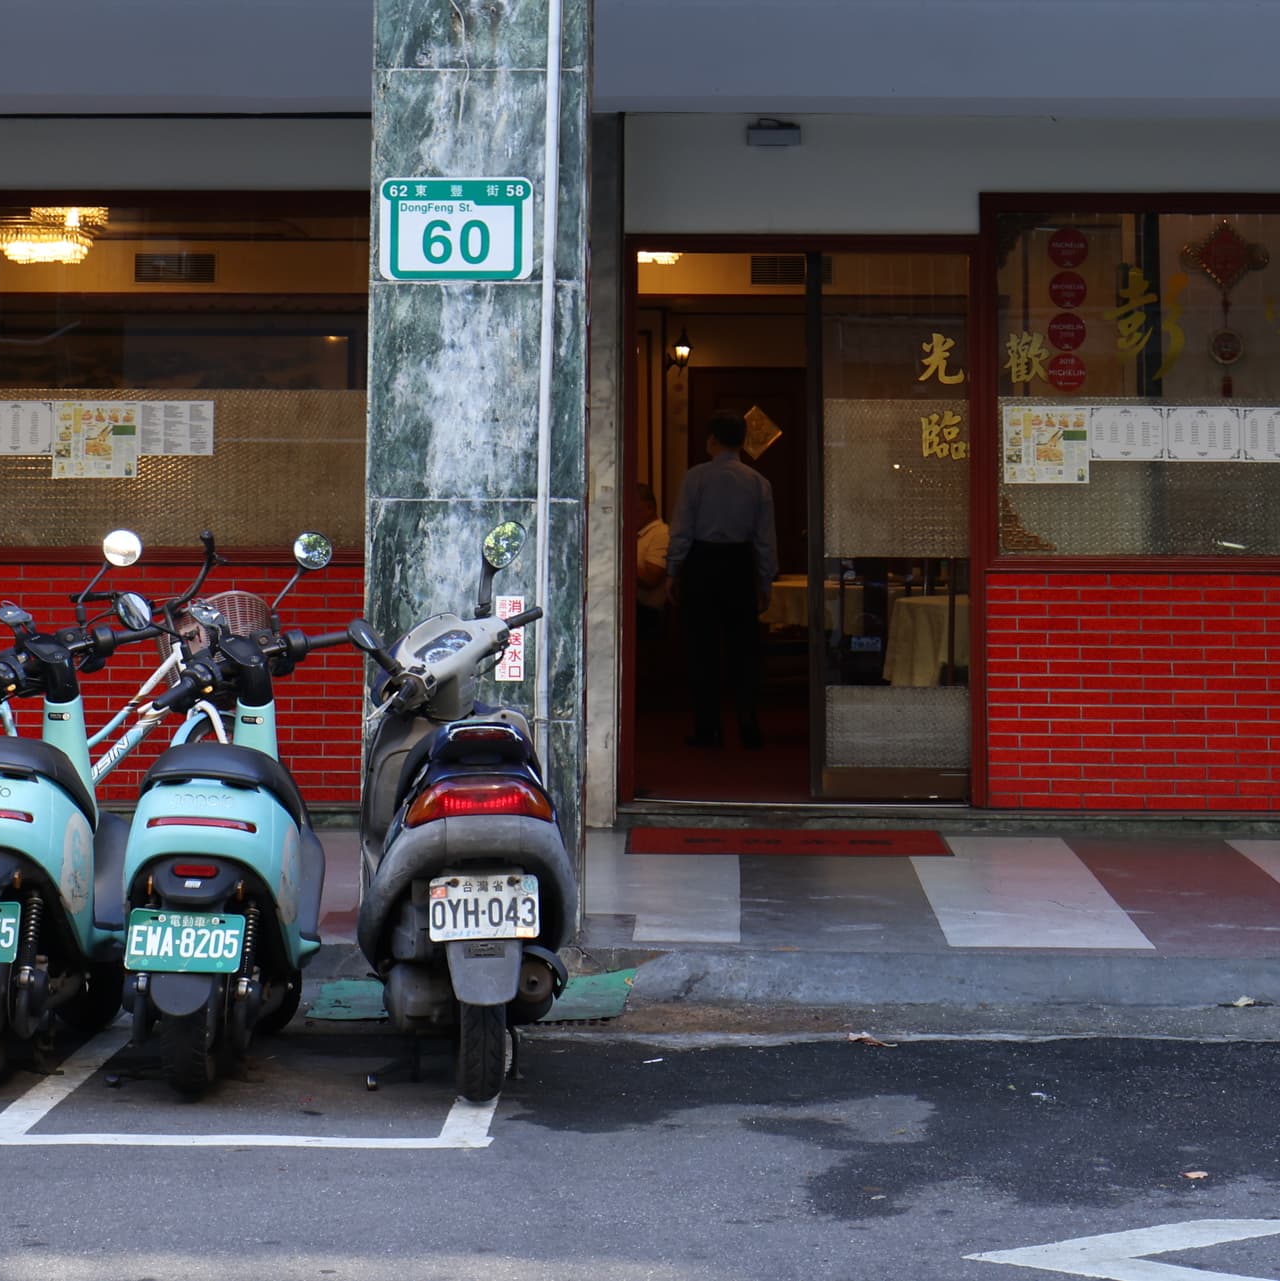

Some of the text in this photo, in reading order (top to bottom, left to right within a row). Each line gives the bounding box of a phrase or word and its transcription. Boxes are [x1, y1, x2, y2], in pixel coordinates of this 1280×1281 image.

[389, 185, 408, 197] 62
[415, 184, 500, 197] 東豐街
[506, 185, 524, 197] 58
[400, 202, 473, 214] DongFeng St.
[422, 219, 490, 265] 60
[1004, 331, 1050, 384] 歡
[918, 332, 969, 460] 光臨
[508, 599, 522, 678] 消送水口
[463, 880, 504, 893] 台灣省
